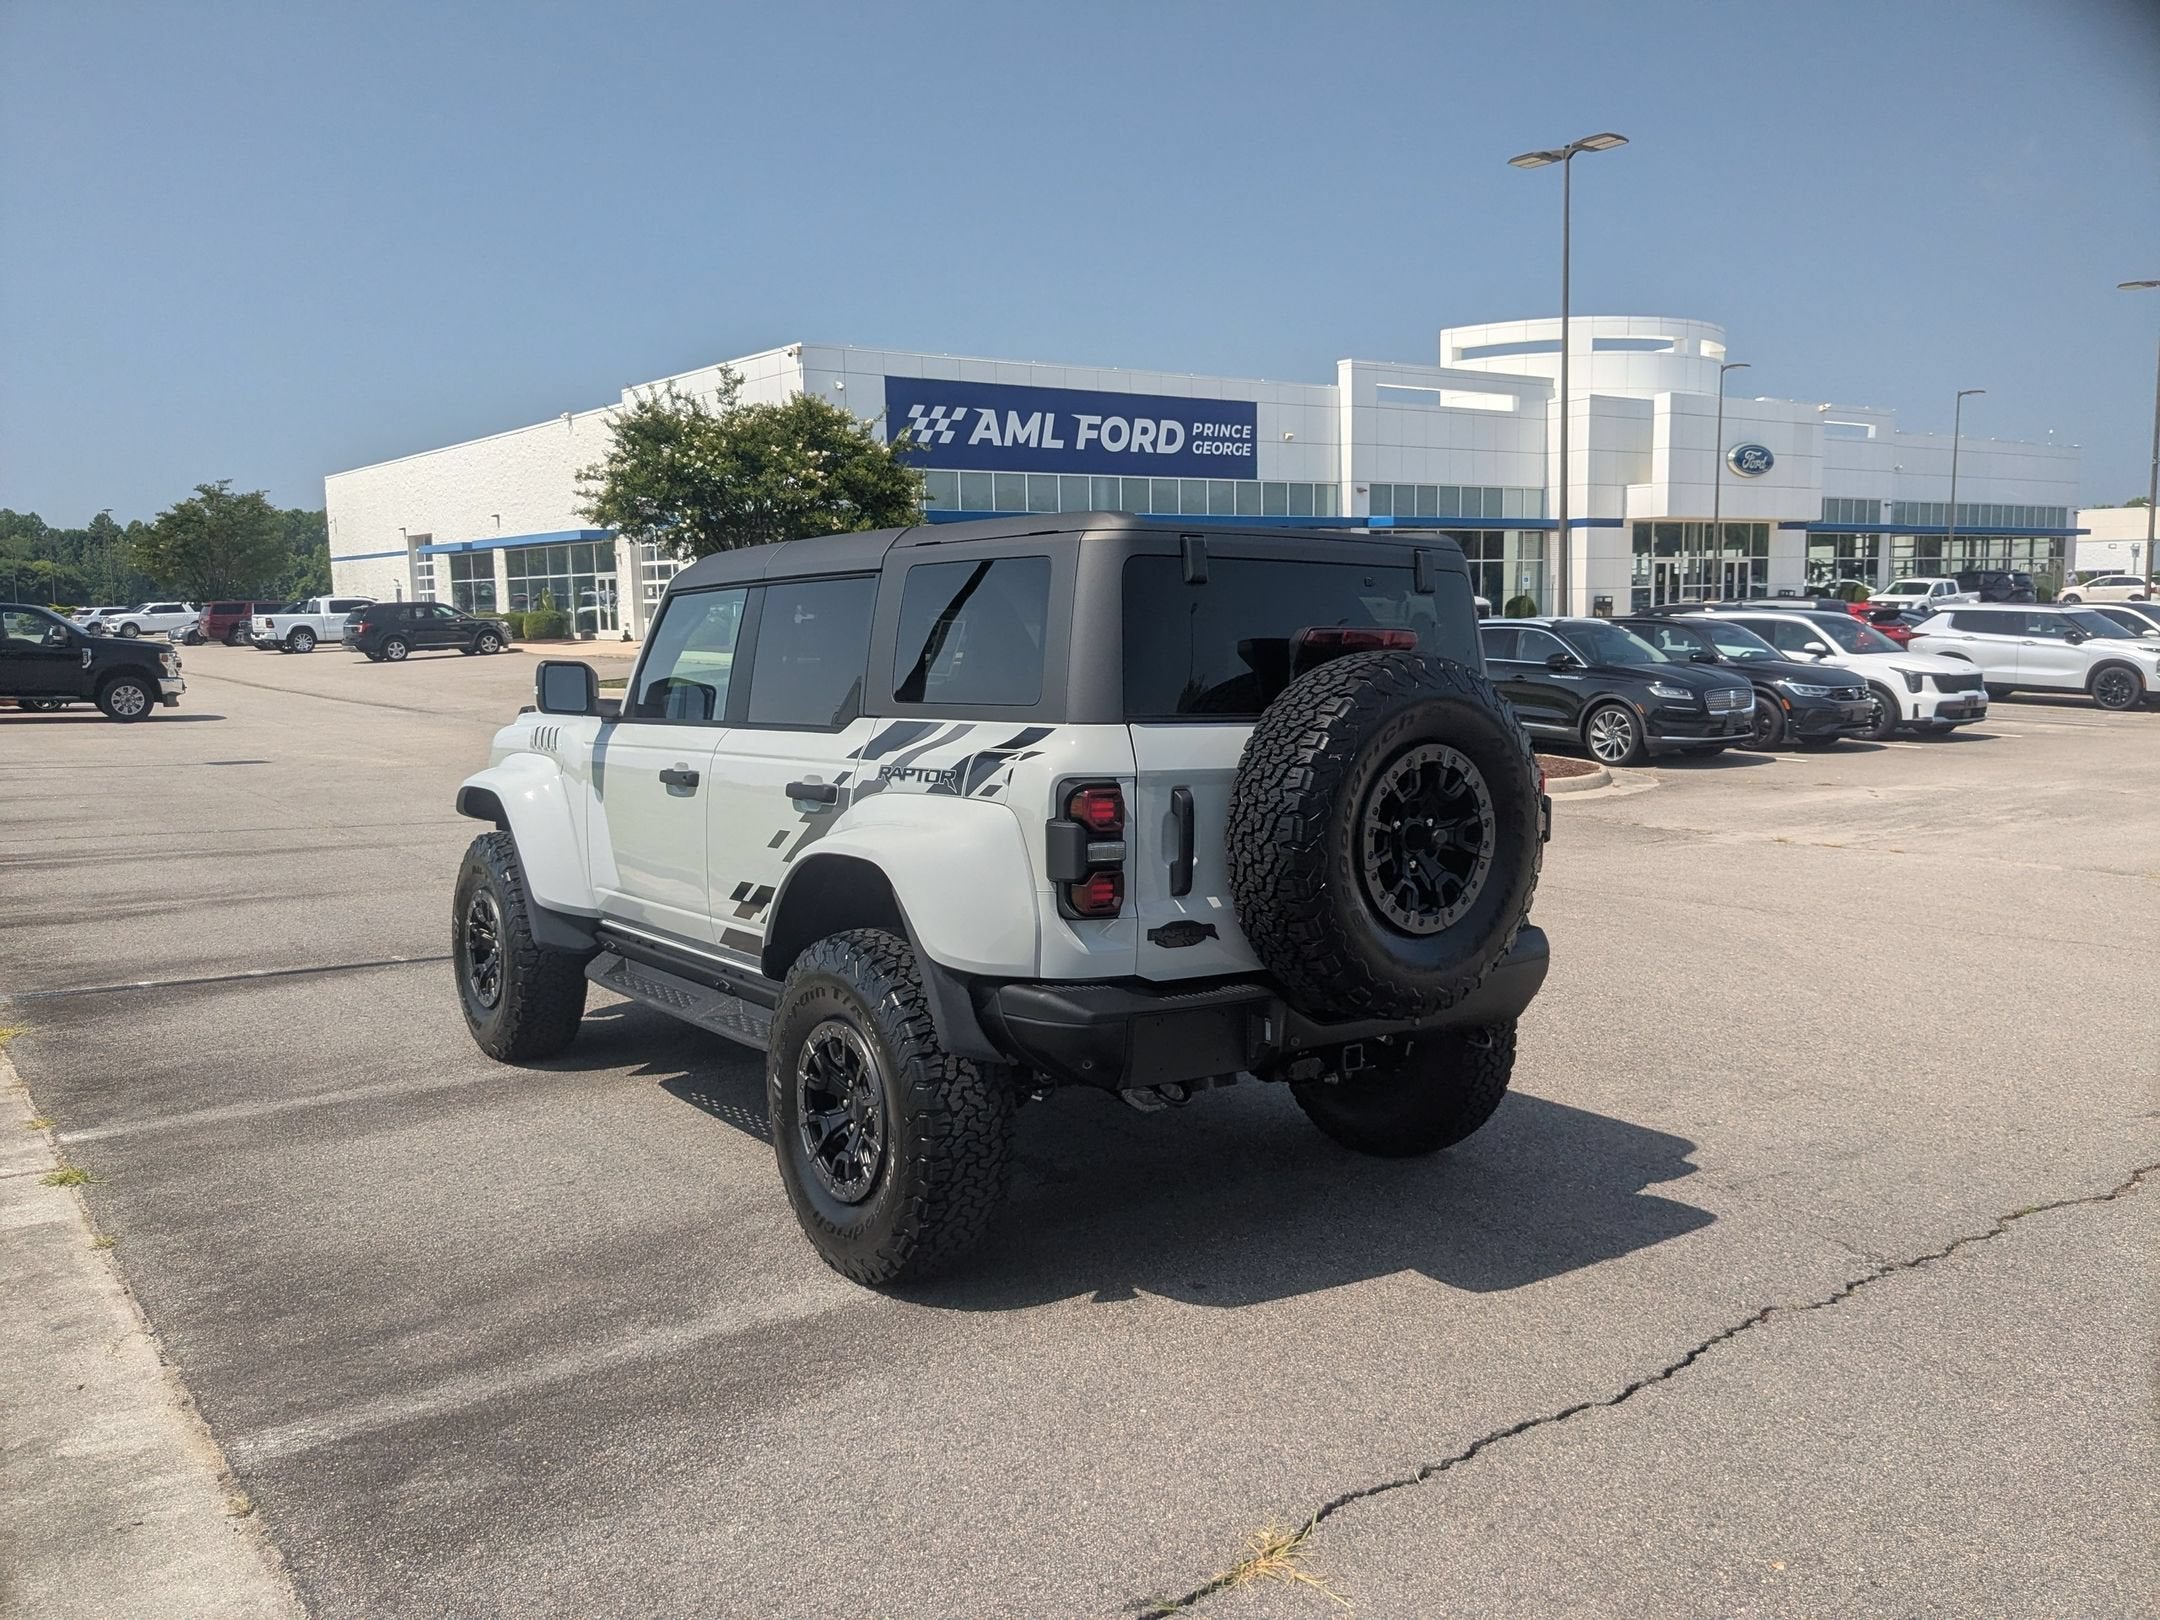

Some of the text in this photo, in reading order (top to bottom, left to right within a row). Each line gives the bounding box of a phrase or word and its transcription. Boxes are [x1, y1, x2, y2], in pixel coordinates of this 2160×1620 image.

[968, 408, 1185, 454] AML FORD
[1192, 423, 1252, 439] PRINCE
[1192, 441, 1252, 456] GEORGE
[1742, 450, 1767, 469] Ford
[878, 764, 957, 794] RAPTOR
